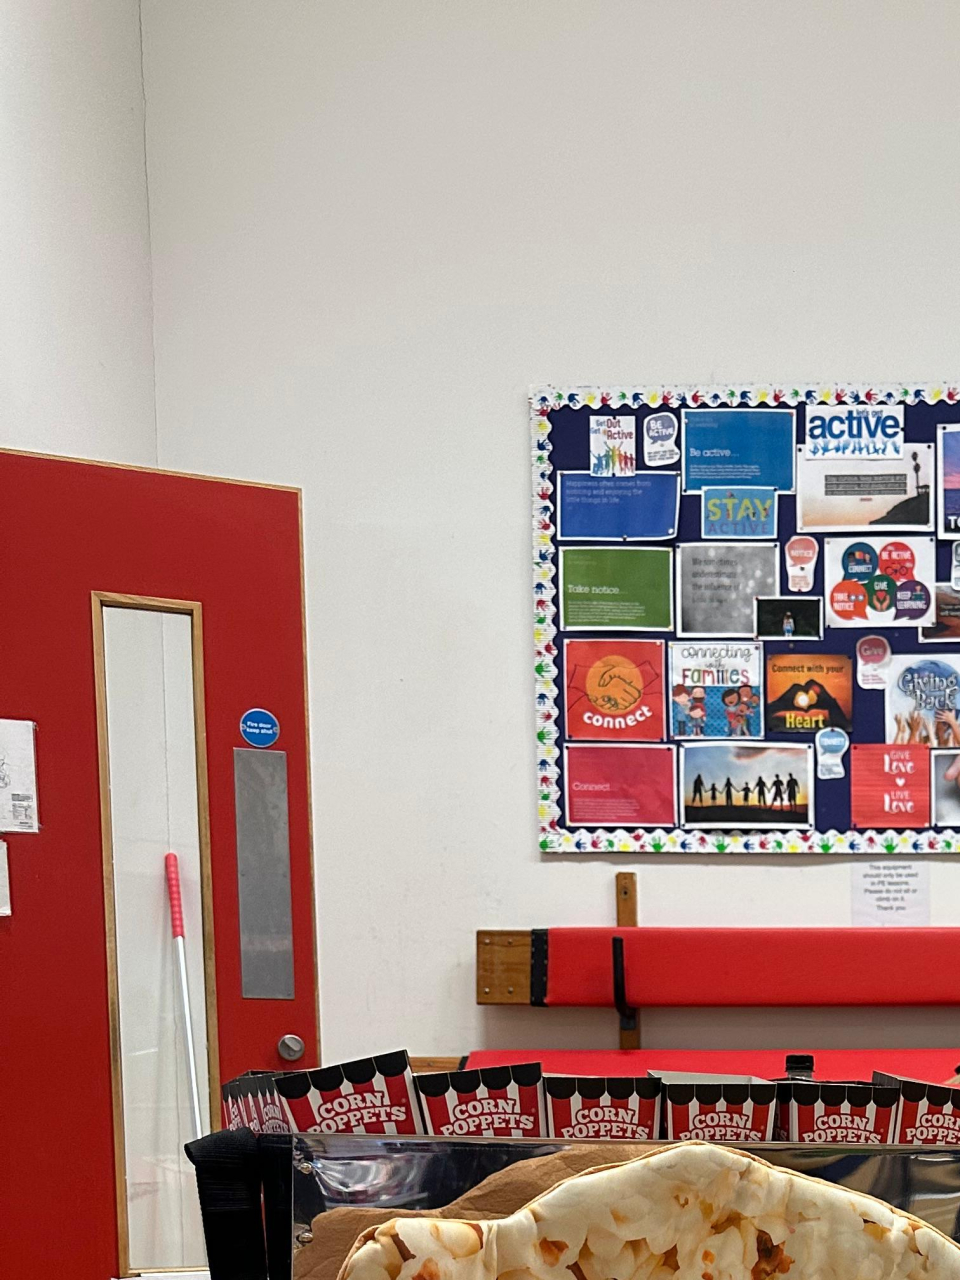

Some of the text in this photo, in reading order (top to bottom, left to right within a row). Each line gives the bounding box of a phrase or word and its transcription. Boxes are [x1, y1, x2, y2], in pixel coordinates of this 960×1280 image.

[606, 418, 621, 428] Out
[649, 419, 663, 429] BE
[808, 410, 900, 440] active
[606, 429, 634, 440] Active
[648, 427, 674, 437] ACTIVE
[689, 448, 701, 457] Be
[706, 498, 773, 522] STAY
[707, 522, 769, 535] ACTIVE
[881, 551, 912, 560] BE ACTIVE
[848, 565, 873, 573] CONNECT
[567, 585, 590, 594] Take
[873, 581, 888, 591] GIVE
[832, 592, 849, 602] TAKE
[896, 591, 911, 600] KEEP
[832, 602, 855, 611] NOTICE
[896, 601, 928, 610] LEARNING
[771, 664, 844, 674] Connect with your
[898, 671, 960, 694] Giving
[913, 686, 960, 711] Back
[582, 705, 653, 729] connect
[785, 712, 825, 729] Heart
[889, 750, 910, 760] GIVE
[890, 790, 910, 800] LIVE
[319, 1092, 383, 1119] CORN
[454, 1099, 515, 1119] CORN
[307, 1106, 407, 1134] POPPETS
[576, 1107, 634, 1124] CORN
[693, 1112, 749, 1128] CORN
[816, 1114, 868, 1130] CORN
[440, 1114, 534, 1136] POPPETS
[561, 1122, 649, 1140] POPPETS
[679, 1126, 762, 1142] POPPETS
[802, 1128, 881, 1144] POPPETS
